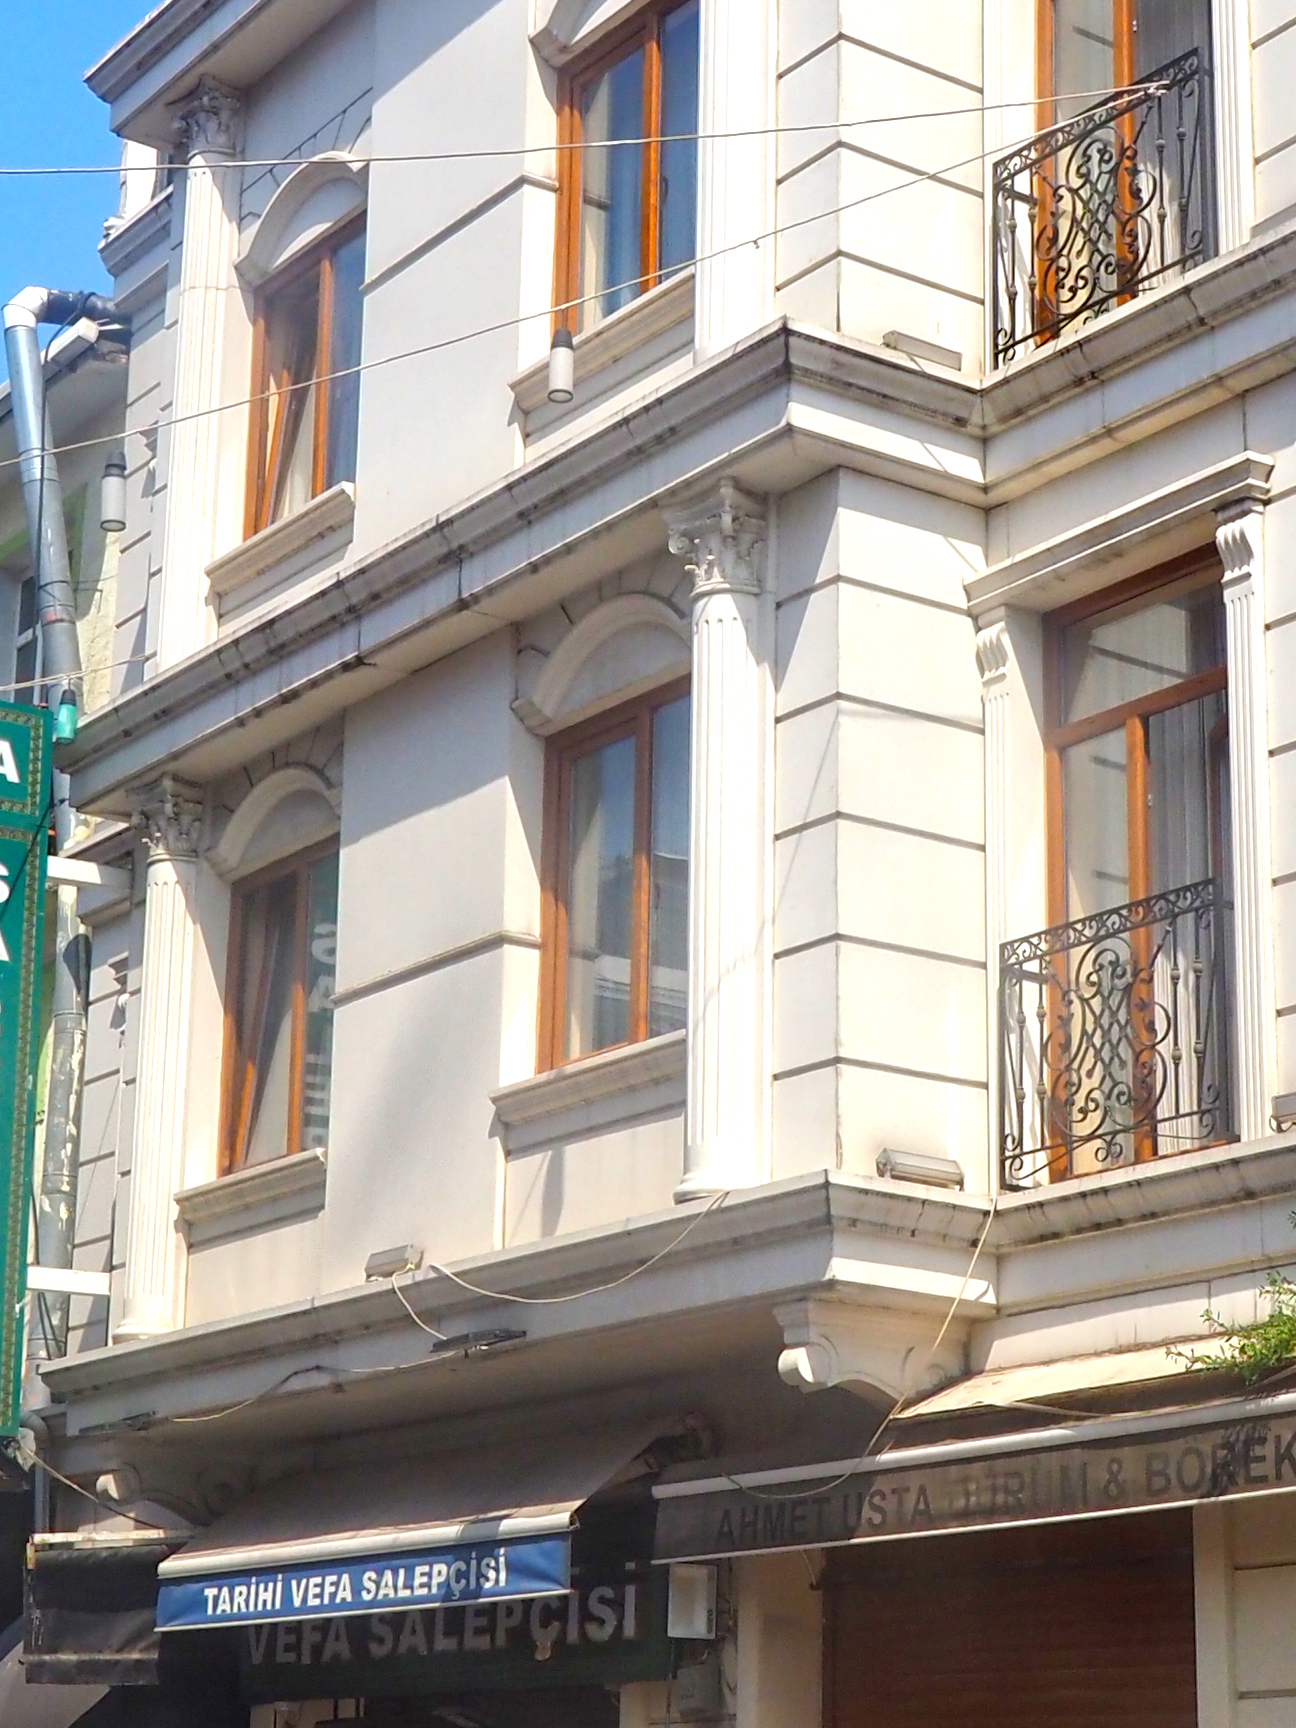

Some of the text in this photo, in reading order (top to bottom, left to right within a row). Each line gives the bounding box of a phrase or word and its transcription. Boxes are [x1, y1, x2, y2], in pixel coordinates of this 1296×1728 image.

[715, 1494, 831, 1547] AHMET
[843, 1482, 933, 1530] USTA
[1104, 1456, 1126, 1503] &
[203, 1547, 508, 1616] TARİHİ VEFA SALEPÇİSİ
[245, 1619, 353, 1667] VEFA
